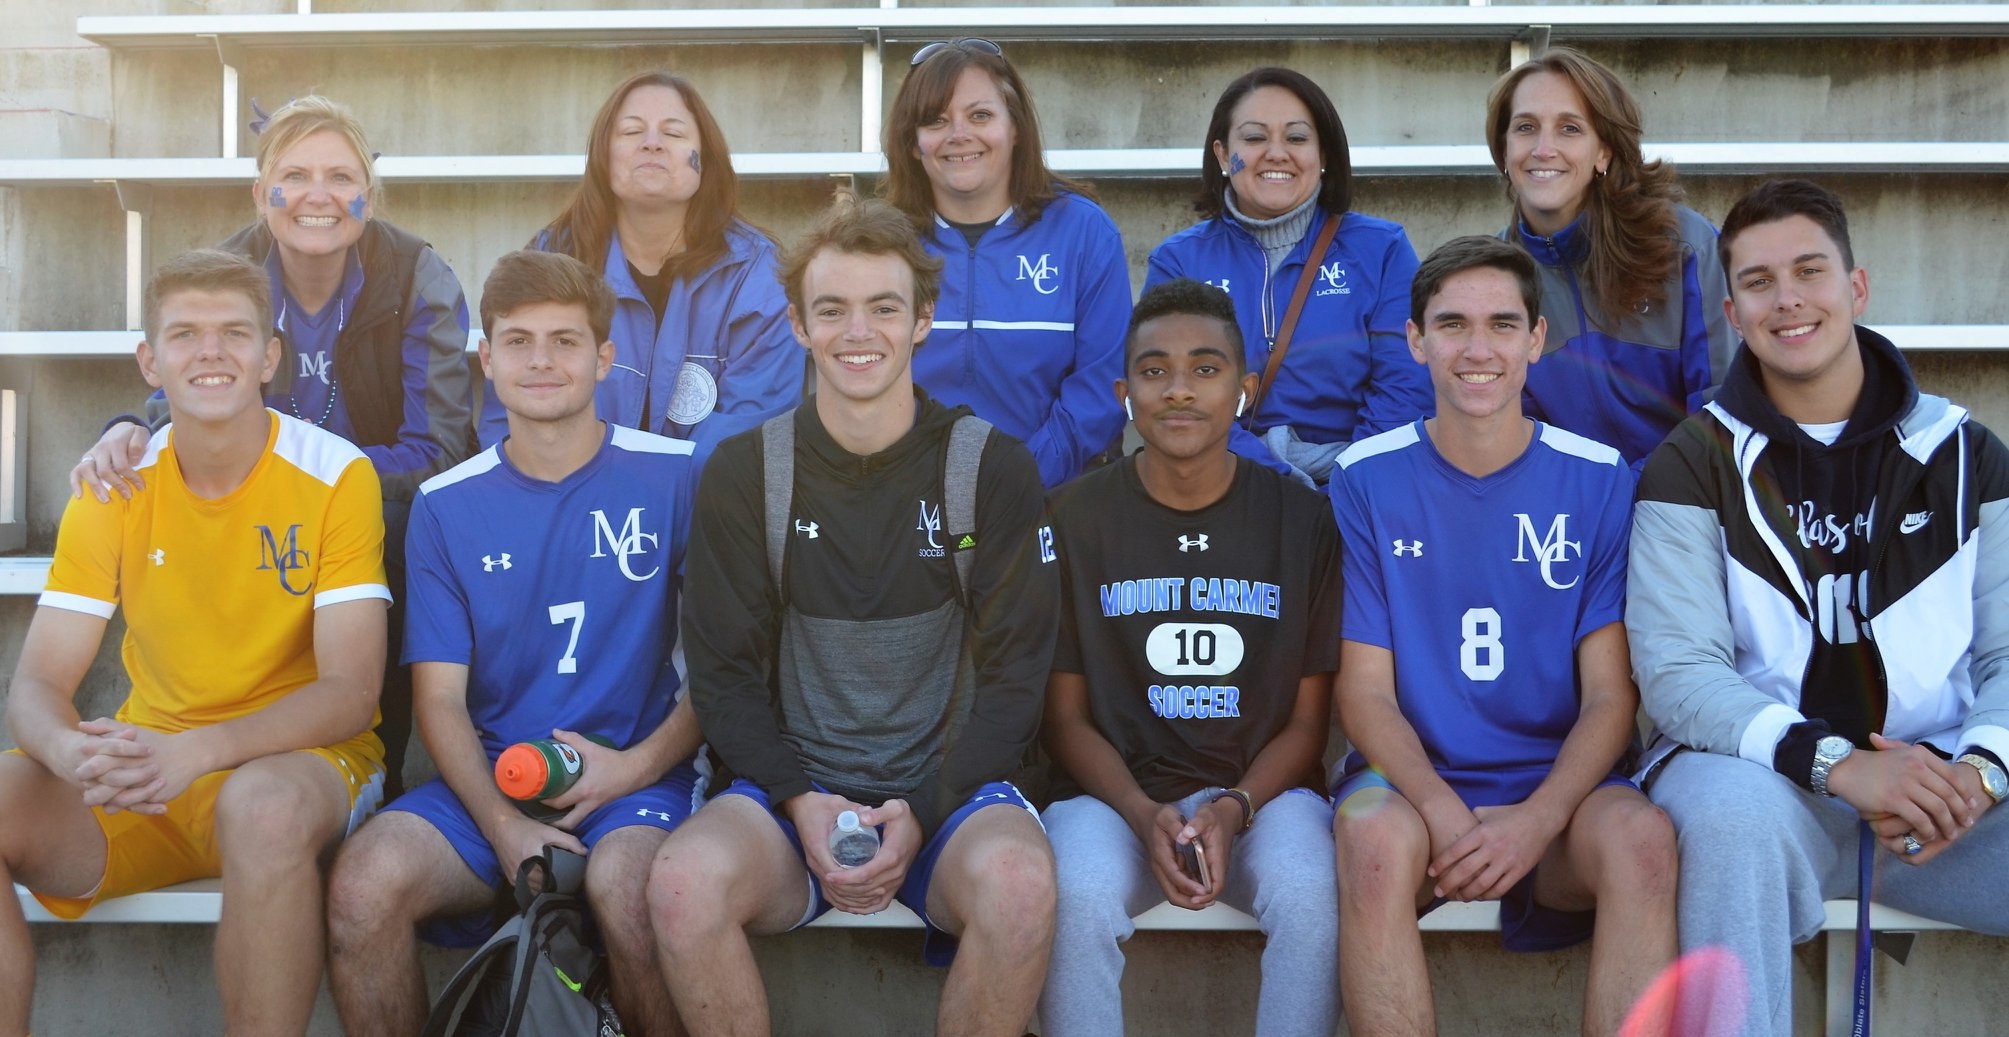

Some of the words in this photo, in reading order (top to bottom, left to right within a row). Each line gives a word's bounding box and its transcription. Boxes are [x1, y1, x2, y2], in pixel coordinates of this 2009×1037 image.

[1016, 253, 1059, 295] MC
[1316, 287, 1351, 297] LACROSSE
[1319, 261, 1347, 288] MC
[1904, 510, 1927, 525] NIKE
[253, 524, 314, 596] MC
[589, 507, 660, 582] MC
[919, 548, 945, 558] SOCCER
[1038, 526, 1057, 564] 12
[1511, 513, 1582, 590] MC
[1100, 577, 1185, 617] MOUNT
[548, 601, 586, 675] 7
[1175, 629, 1216, 666] 10
[1460, 607, 1505, 682] 8
[1148, 685, 1241, 720] SOCCER
